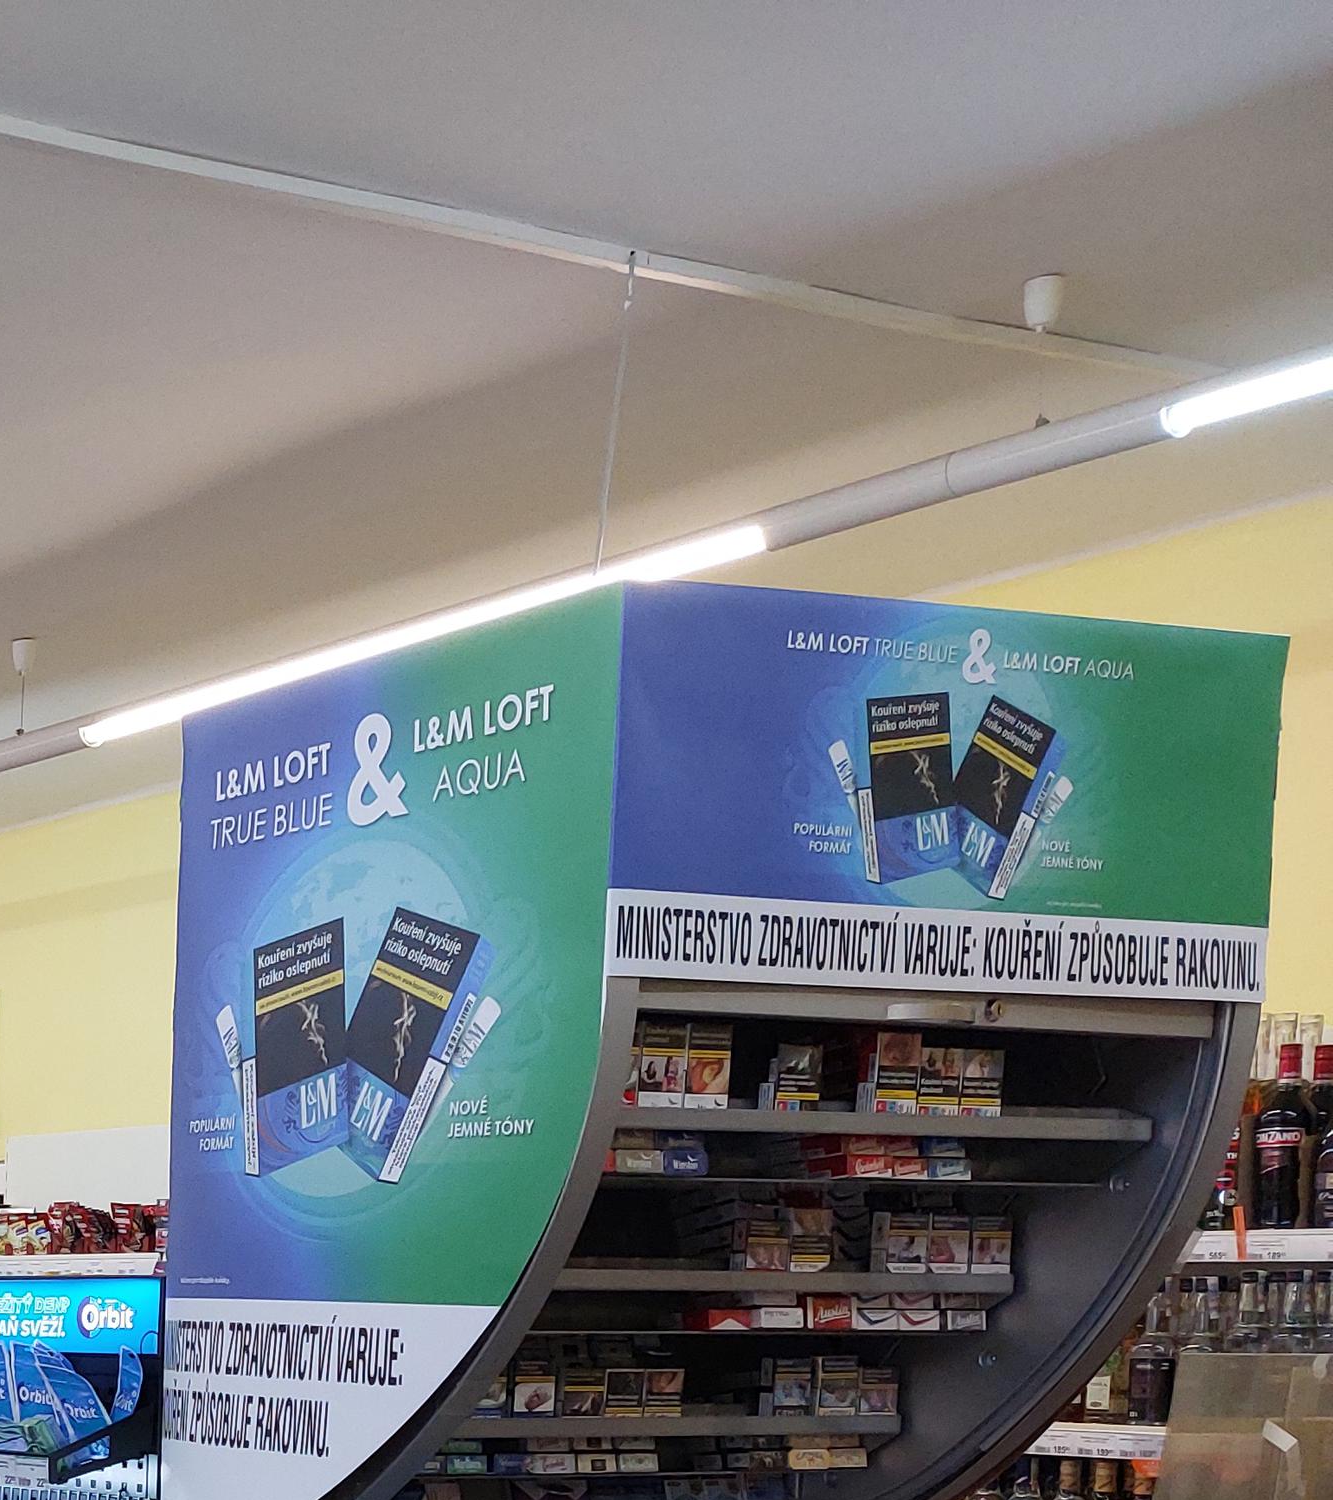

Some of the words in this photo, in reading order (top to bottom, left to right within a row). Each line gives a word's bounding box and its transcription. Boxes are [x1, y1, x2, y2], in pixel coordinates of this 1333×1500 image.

[786, 629, 823, 652] L&M
[829, 633, 870, 656] LOFT
[874, 638, 914, 660] TRUE
[917, 643, 958, 664] BLUE
[962, 628, 996, 684] &
[1003, 650, 1037, 671] L&M
[1043, 655, 1081, 674] LOFT
[1084, 659, 1134, 680] AQUA
[413, 704, 472, 753] L&M
[484, 683, 554, 736] LOFT
[215, 759, 265, 802] L&M
[273, 742, 332, 785] LOFT
[347, 713, 409, 826] &
[433, 749, 525, 802] AQUA
[211, 808, 266, 849] TRUE
[274, 793, 333, 838] BLUE
[916, 812, 950, 851] L&M
[961, 821, 996, 868] L&M
[257, 942, 295, 970] Kouření
[296, 931, 333, 957] zvyšuje
[392, 916, 427, 944] Kouření
[426, 930, 463, 957] zvyšuje
[408, 947, 451, 976] oslepnutí
[616, 904, 753, 965] MINISTERSTVO
[758, 912, 899, 973] ZDRAVOTNICTVÍ
[903, 924, 978, 978] VARUJE:
[983, 919, 1063, 983] KOUŘENÍ
[1066, 922, 1171, 988] ZPŮSOBUJE
[1174, 936, 1261, 992] RAKOVINU.
[285, 952, 331, 979] oslepnutí
[300, 1073, 337, 1129] L&M
[351, 1081, 393, 1142] L&M
[447, 1116, 492, 1138] JEMNÉ
[495, 1115, 535, 1136] TÓNY
[449, 1094, 488, 1116] NOVÉ
[81, 1304, 135, 1330] Orbit
[225, 1313, 336, 1382] ZDRAVOTNICTVÍ
[336, 1327, 404, 1386] VARUJE:
[189, 1377, 253, 1449] ZPŮSOBUJE
[253, 1398, 330, 1458] RAKOVINU.
